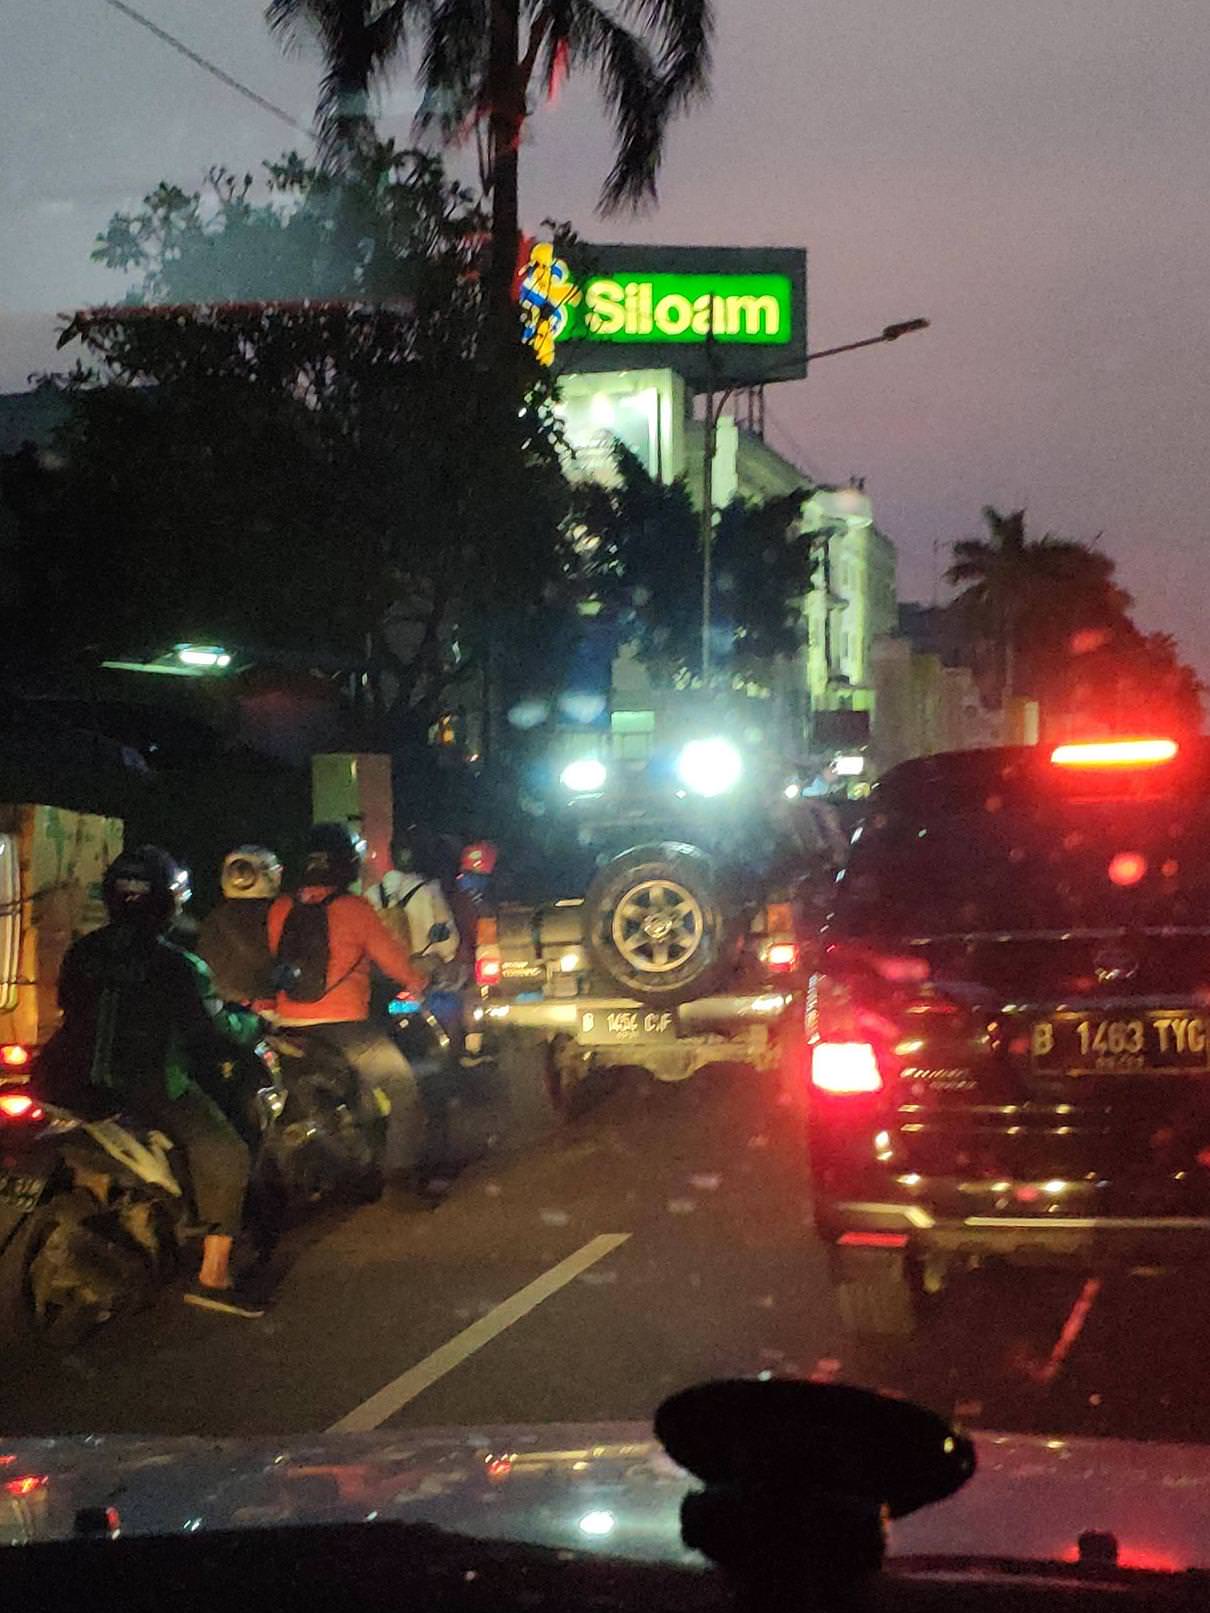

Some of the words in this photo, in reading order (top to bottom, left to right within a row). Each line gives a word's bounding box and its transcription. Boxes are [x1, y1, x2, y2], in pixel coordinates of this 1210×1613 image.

[584, 279, 781, 335] Siloam
[1032, 1023, 1055, 1056] B
[1076, 1020, 1145, 1055] 1463
